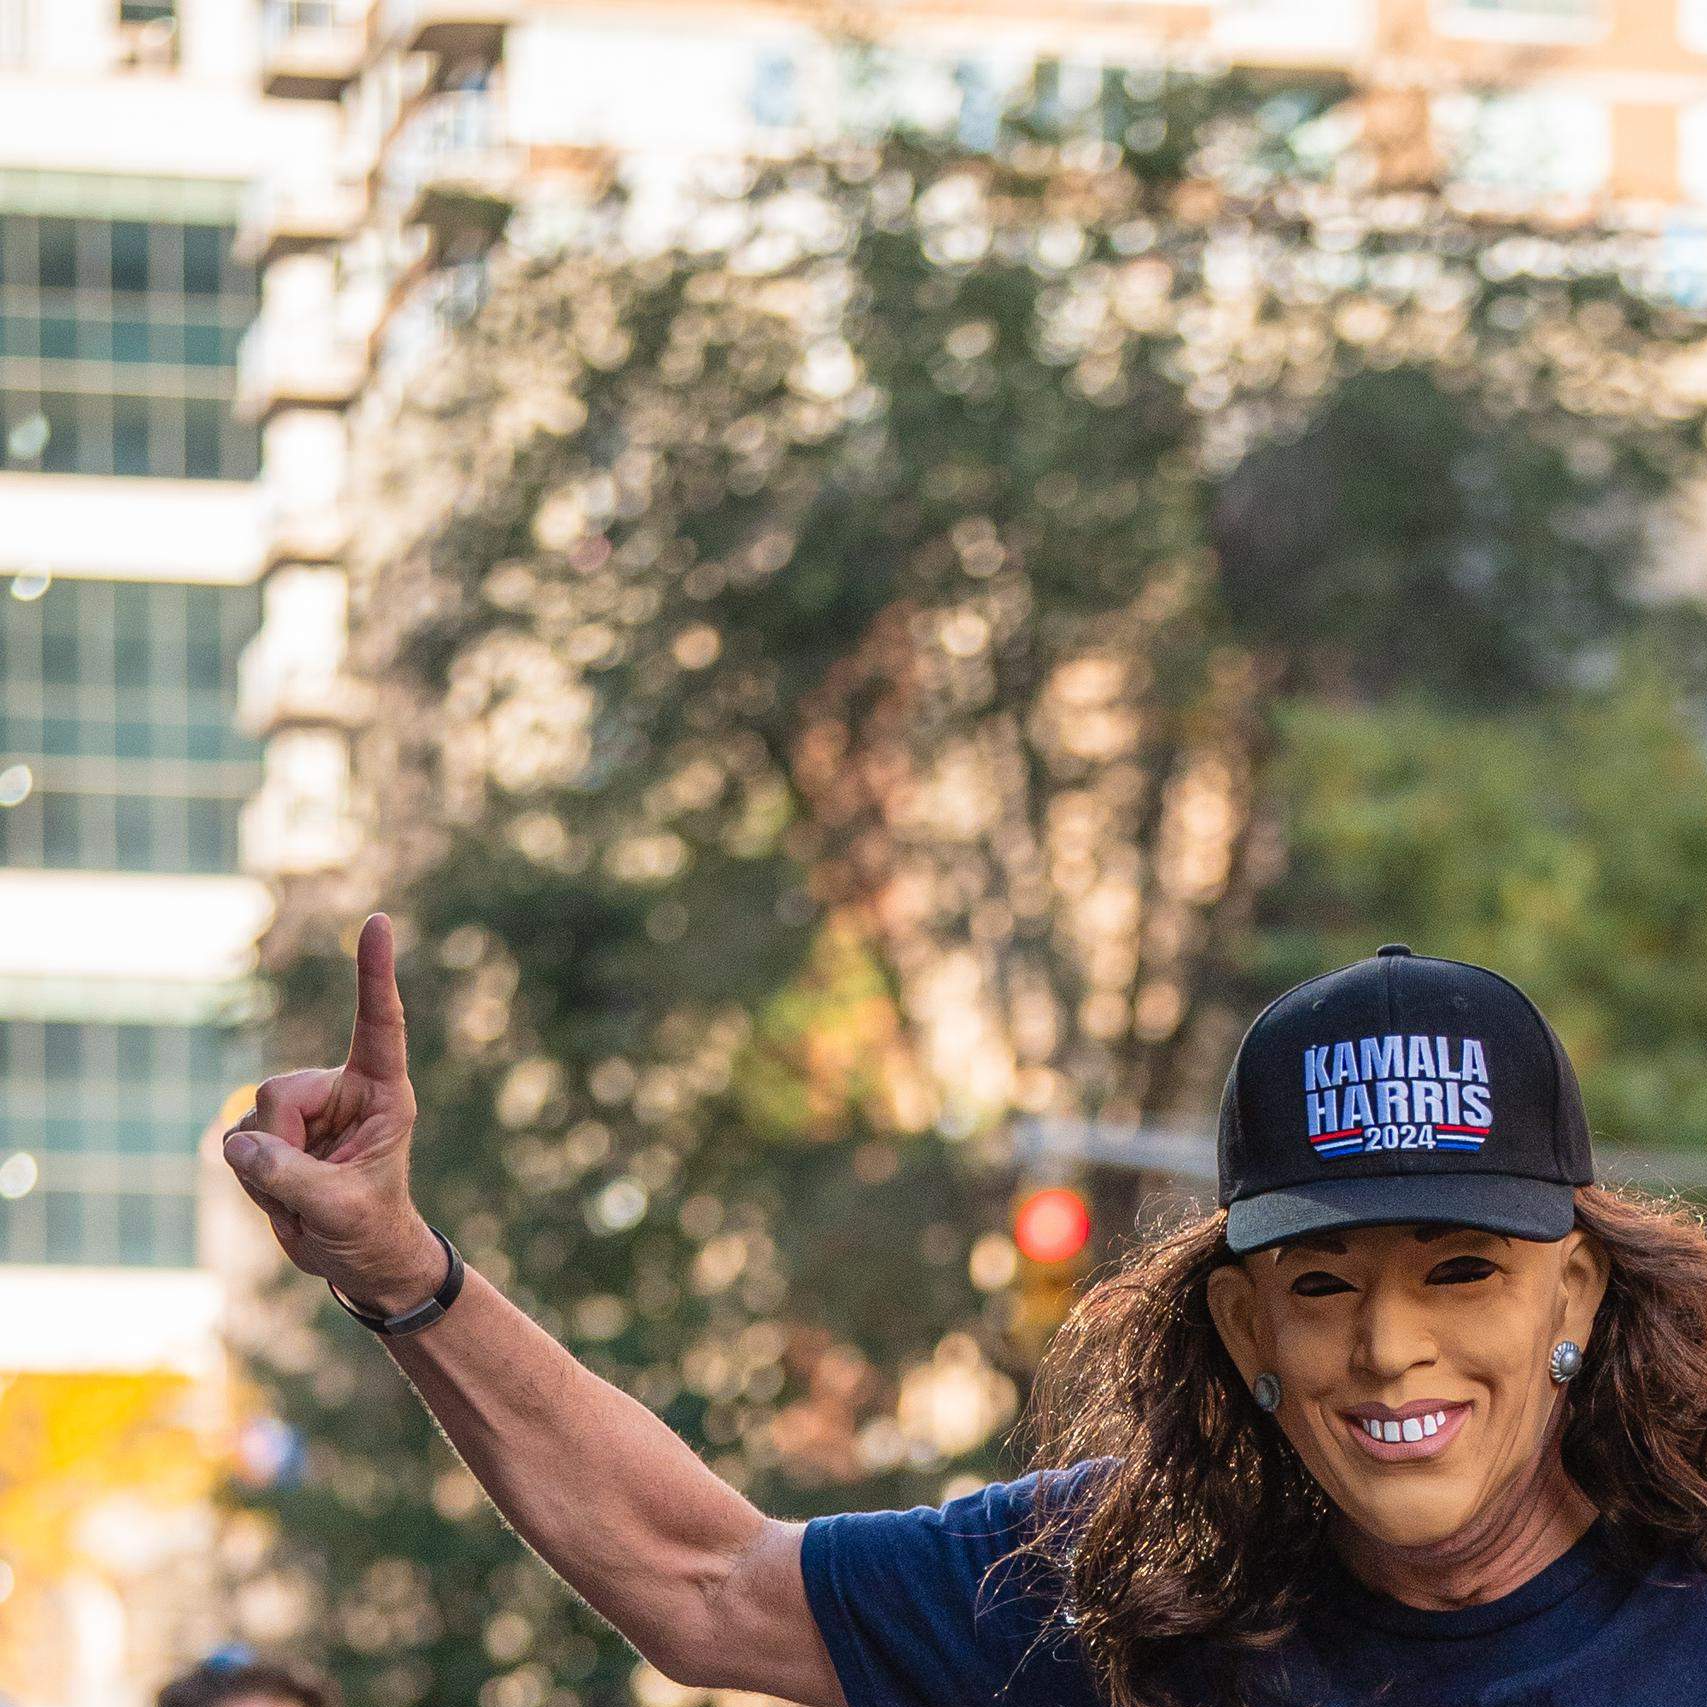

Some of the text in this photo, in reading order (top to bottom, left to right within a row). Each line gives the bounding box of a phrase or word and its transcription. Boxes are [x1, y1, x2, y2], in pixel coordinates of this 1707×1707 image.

[1304, 1035, 1490, 1092] KAMALA
[1306, 1079, 1494, 1135] HARRIS
[1363, 1124, 1437, 1153] 2024
